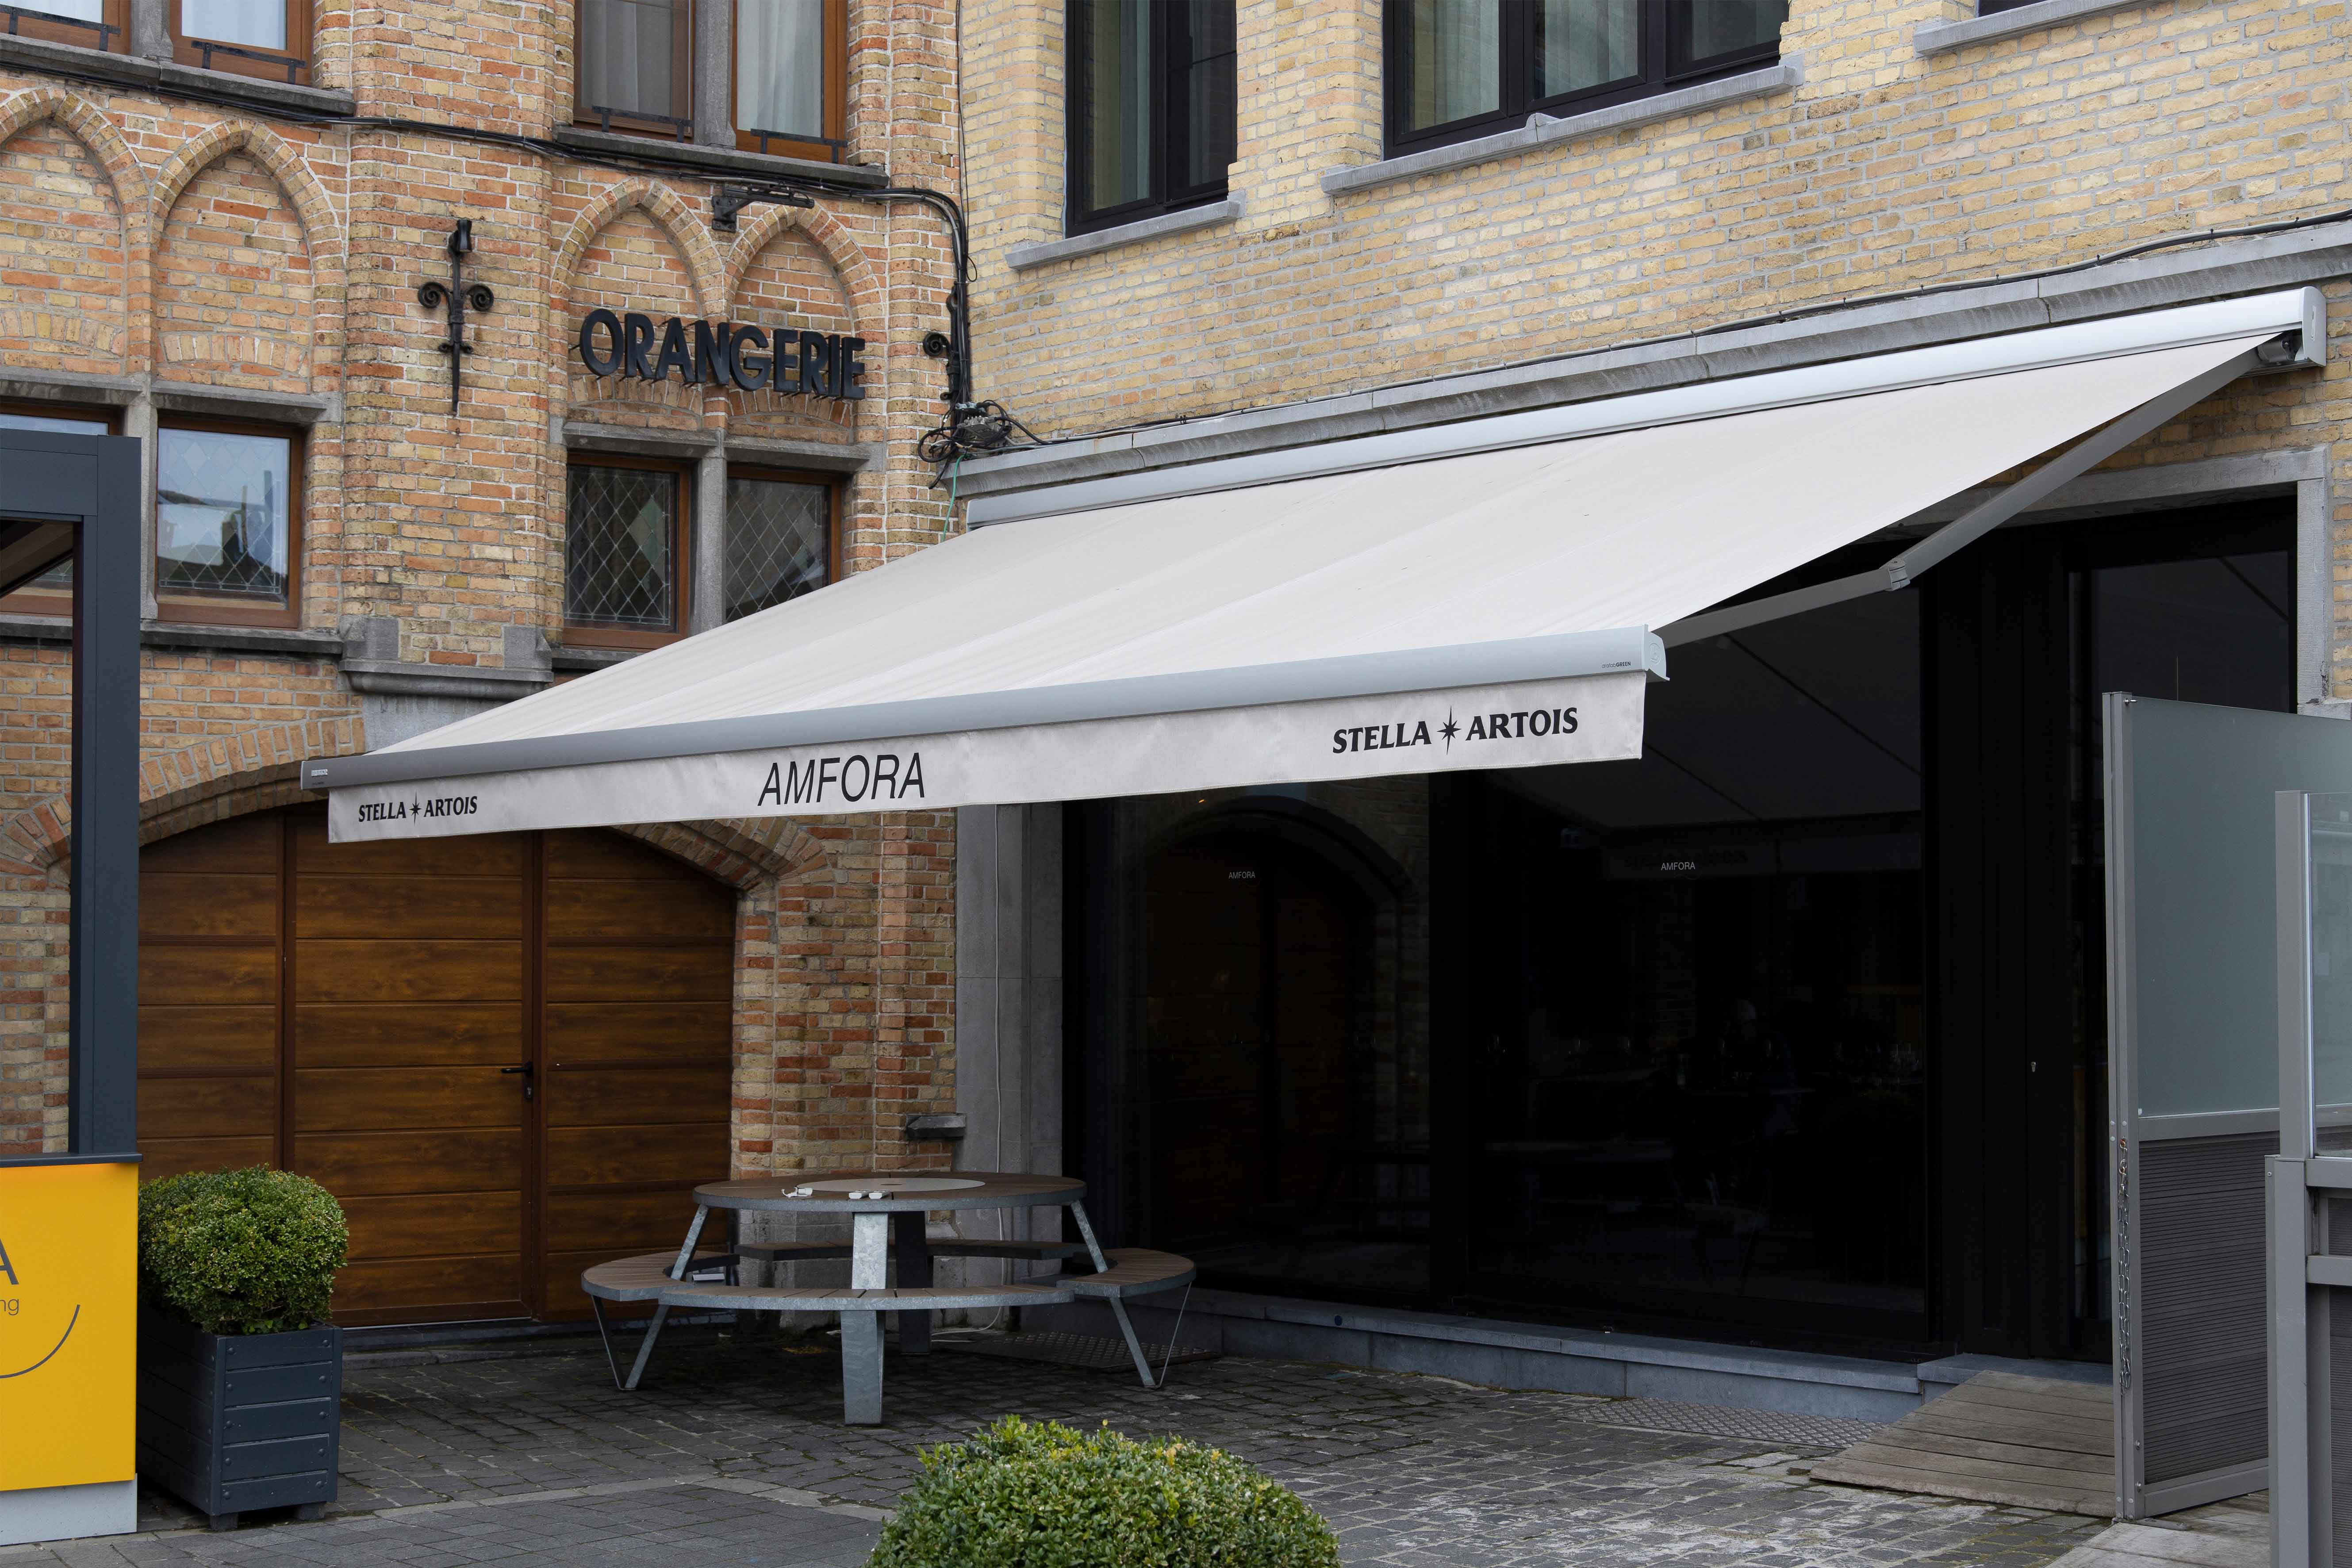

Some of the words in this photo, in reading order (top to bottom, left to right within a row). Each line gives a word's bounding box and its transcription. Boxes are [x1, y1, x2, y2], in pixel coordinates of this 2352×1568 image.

[580, 309, 865, 400] ORANGERIE
[1333, 721, 1432, 754] STELLA
[1466, 707, 1578, 741] ARTOIS
[757, 752, 925, 807] AMFORA
[358, 801, 407, 822] STELLA
[423, 795, 478, 818] ARTOIS
[1228, 870, 1256, 879] AMFORA
[1661, 861, 1696, 871] AMFORA
